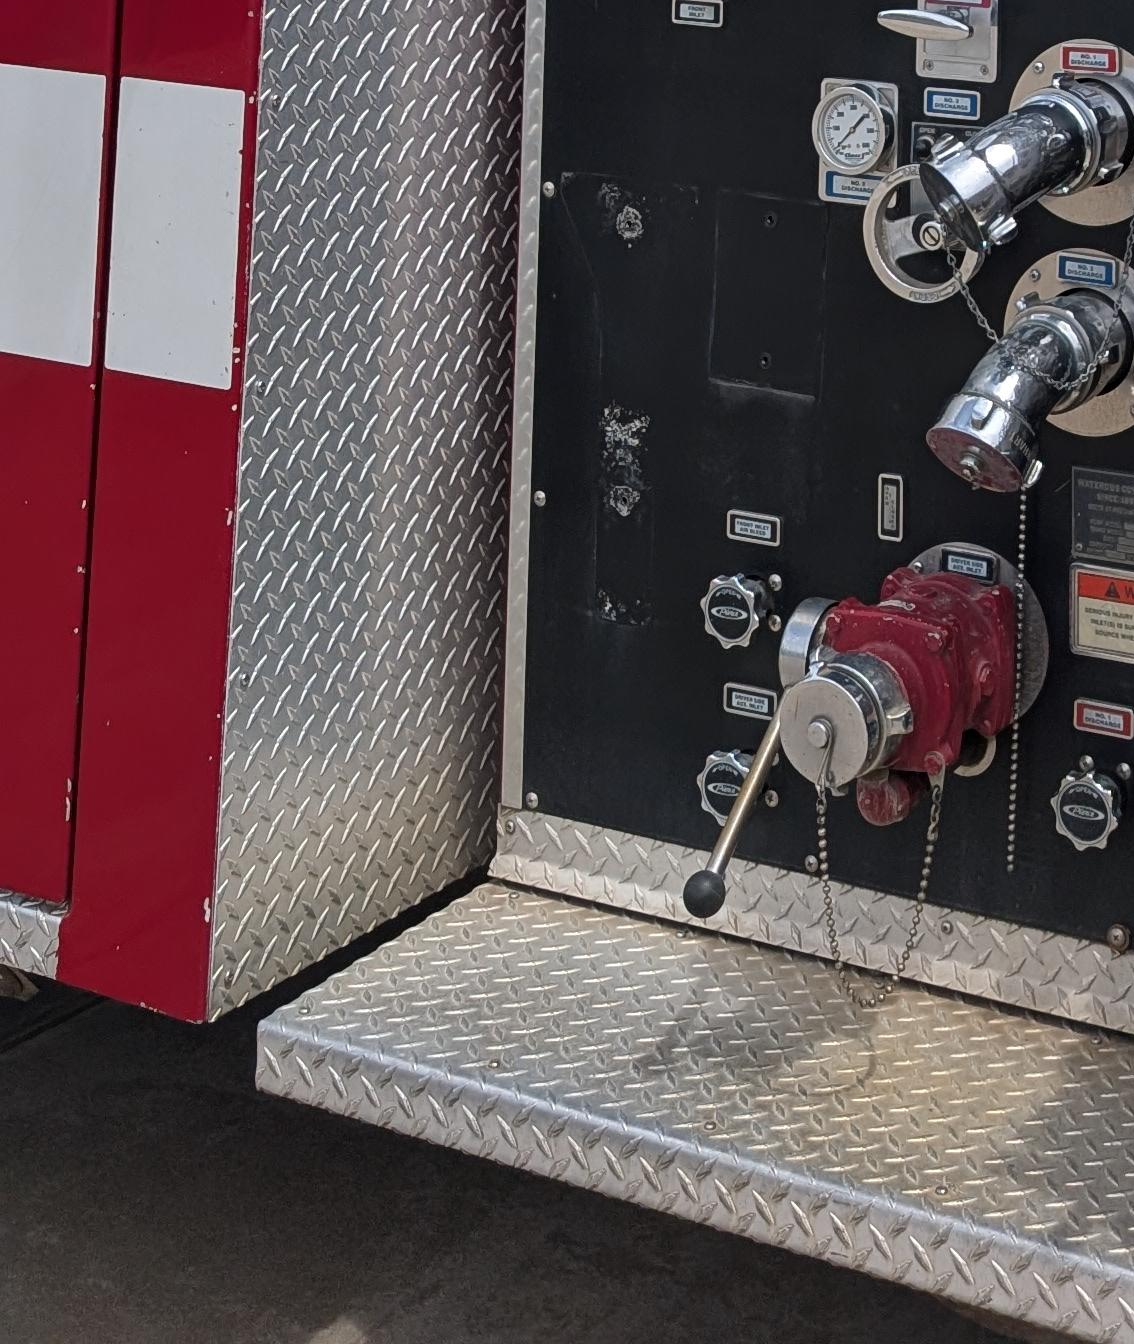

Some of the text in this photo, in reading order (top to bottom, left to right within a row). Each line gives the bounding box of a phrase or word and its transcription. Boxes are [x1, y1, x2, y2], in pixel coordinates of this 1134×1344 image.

[1070, 59, 1106, 67] DISCHARGE
[934, 102, 969, 110] DISCHARGE
[1067, 269, 1103, 279] DISCHARGE
[736, 520, 753, 529] FRONT
[1084, 607, 1111, 617] SERIOUS
[1111, 611, 1133, 621] INJURY
[1094, 630, 1120, 640] SOURCE
[1085, 717, 1121, 729] DISCHARGE
